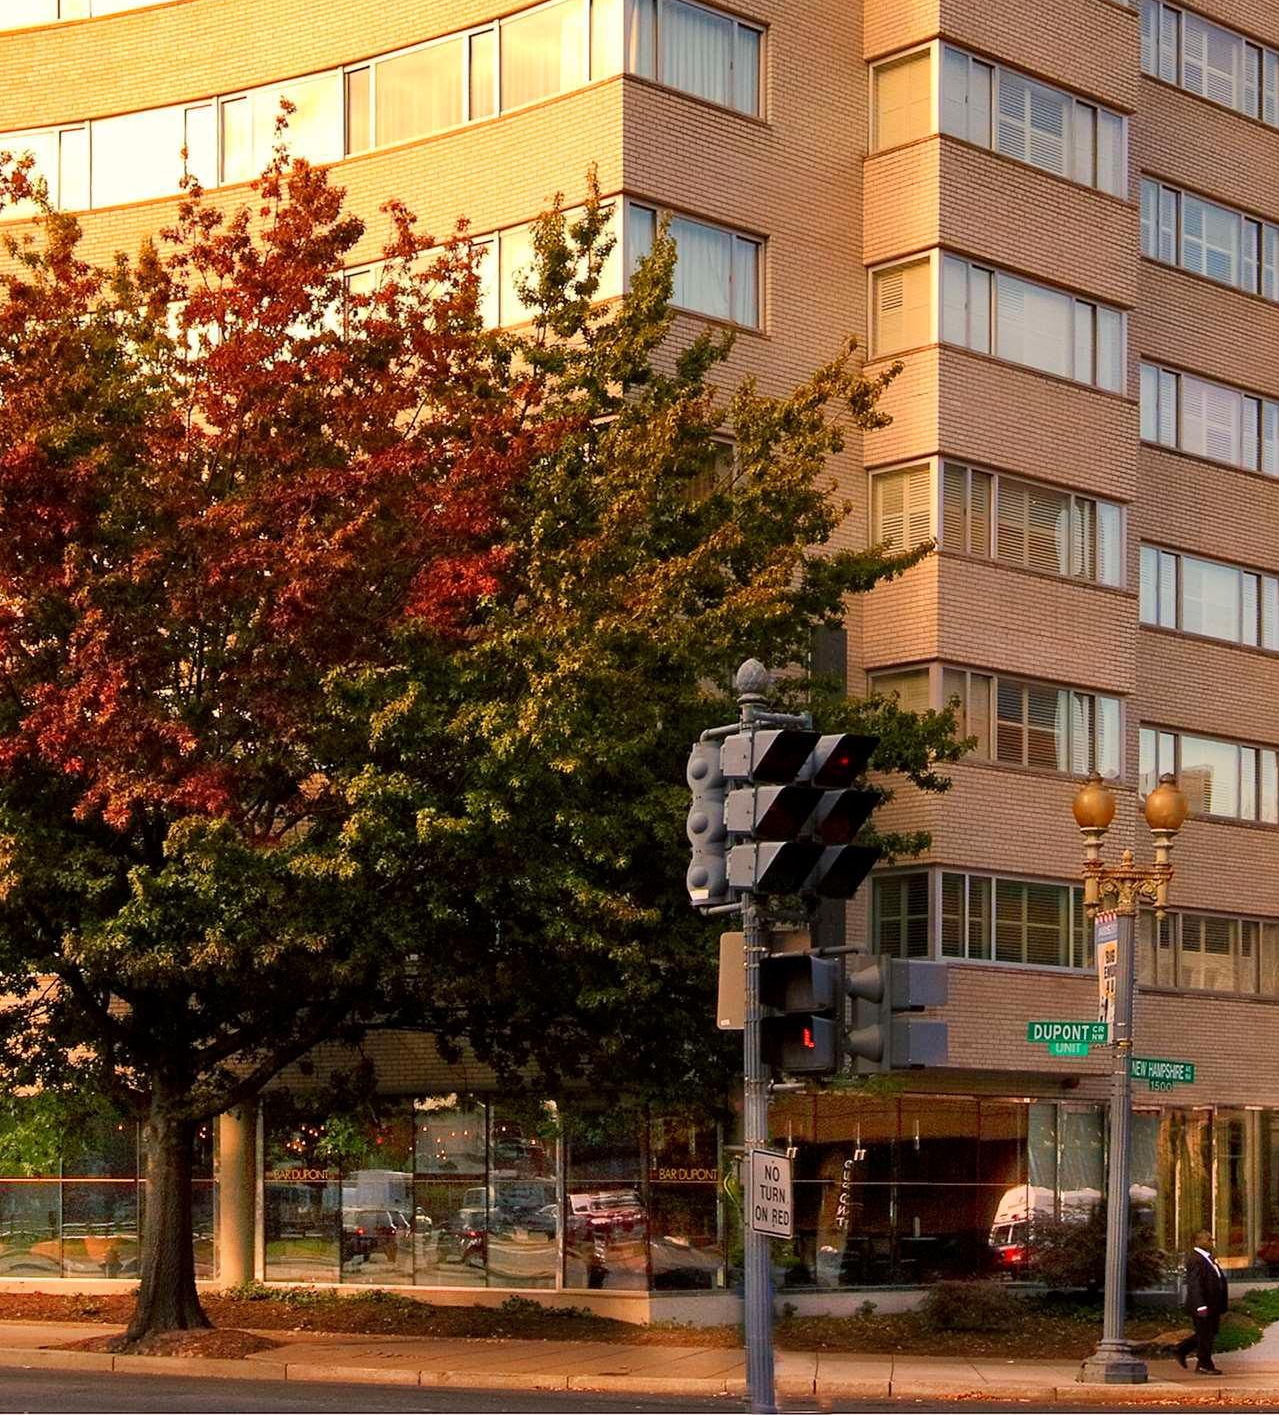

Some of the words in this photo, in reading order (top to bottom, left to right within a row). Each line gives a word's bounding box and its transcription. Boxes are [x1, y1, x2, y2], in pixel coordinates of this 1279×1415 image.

[1034, 1024, 1089, 1040] DUPONT
[1055, 1042, 1082, 1053] UNIT
[1130, 1060, 1146, 1076] NEW
[1148, 1061, 1184, 1080] HAMPSHIRE
[1151, 1080, 1173, 1092] 1500
[291, 1169, 329, 1179] DUPONT
[659, 1168, 677, 1180] BAR
[678, 1168, 718, 1180] DUPONT
[764, 1165, 780, 1182] NO
[760, 1184, 786, 1204] TURN
[755, 1205, 768, 1222] ON
[772, 1208, 790, 1226] RED
